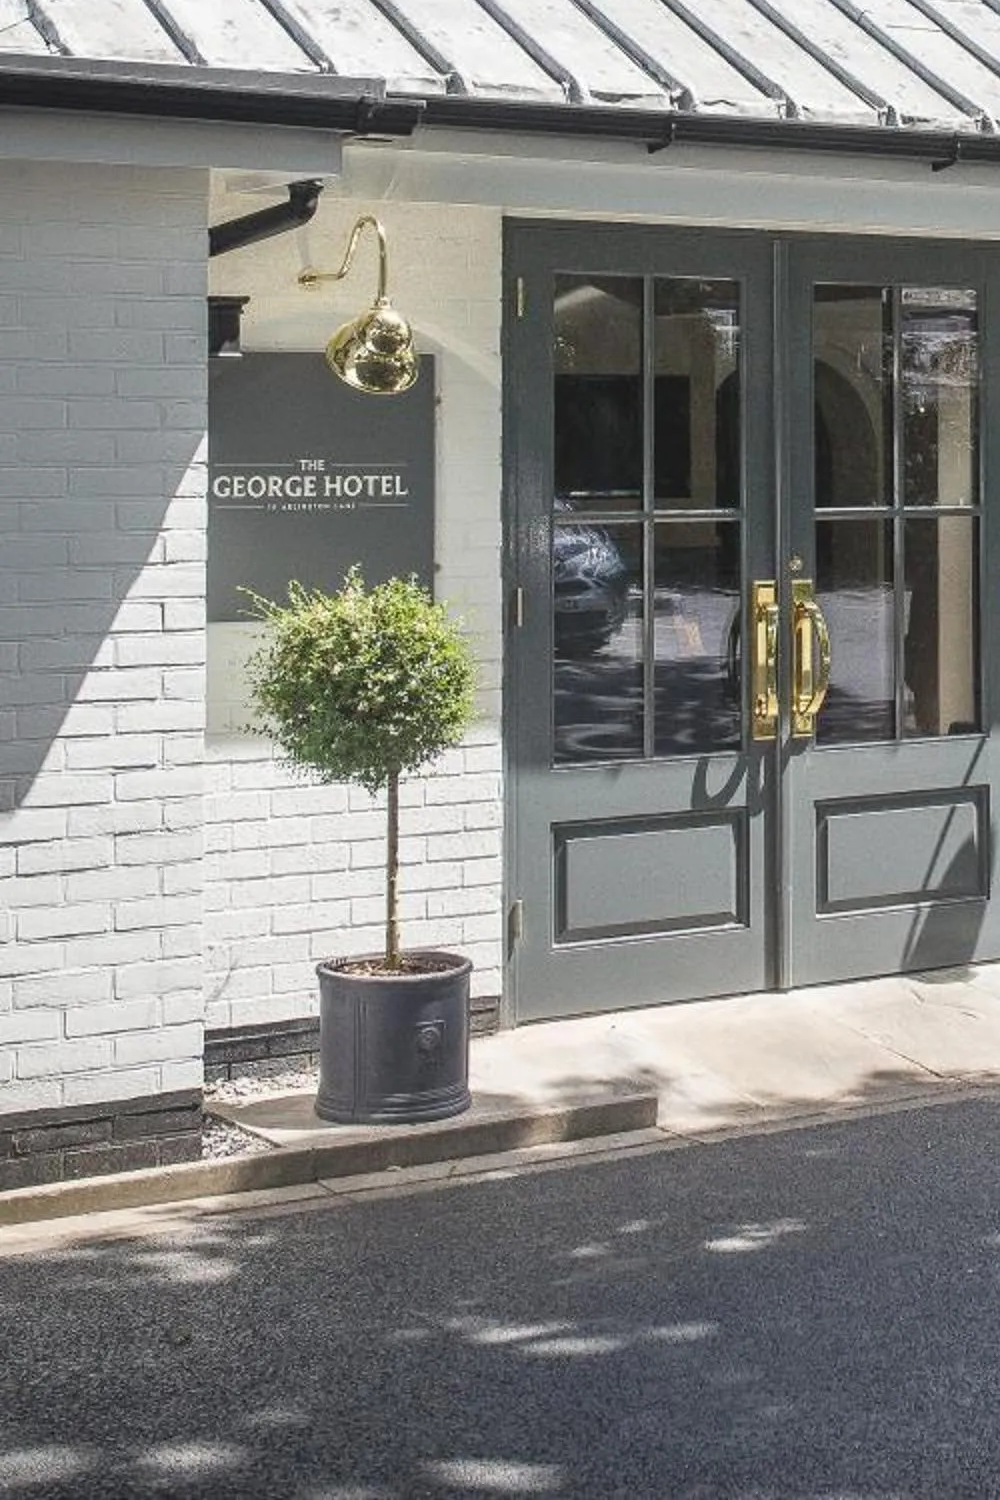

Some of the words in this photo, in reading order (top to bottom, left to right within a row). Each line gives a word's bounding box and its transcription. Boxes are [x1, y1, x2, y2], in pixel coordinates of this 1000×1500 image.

[299, 459, 325, 470] THE
[213, 475, 317, 498] GEORGE
[324, 474, 409, 497] HOTEL
